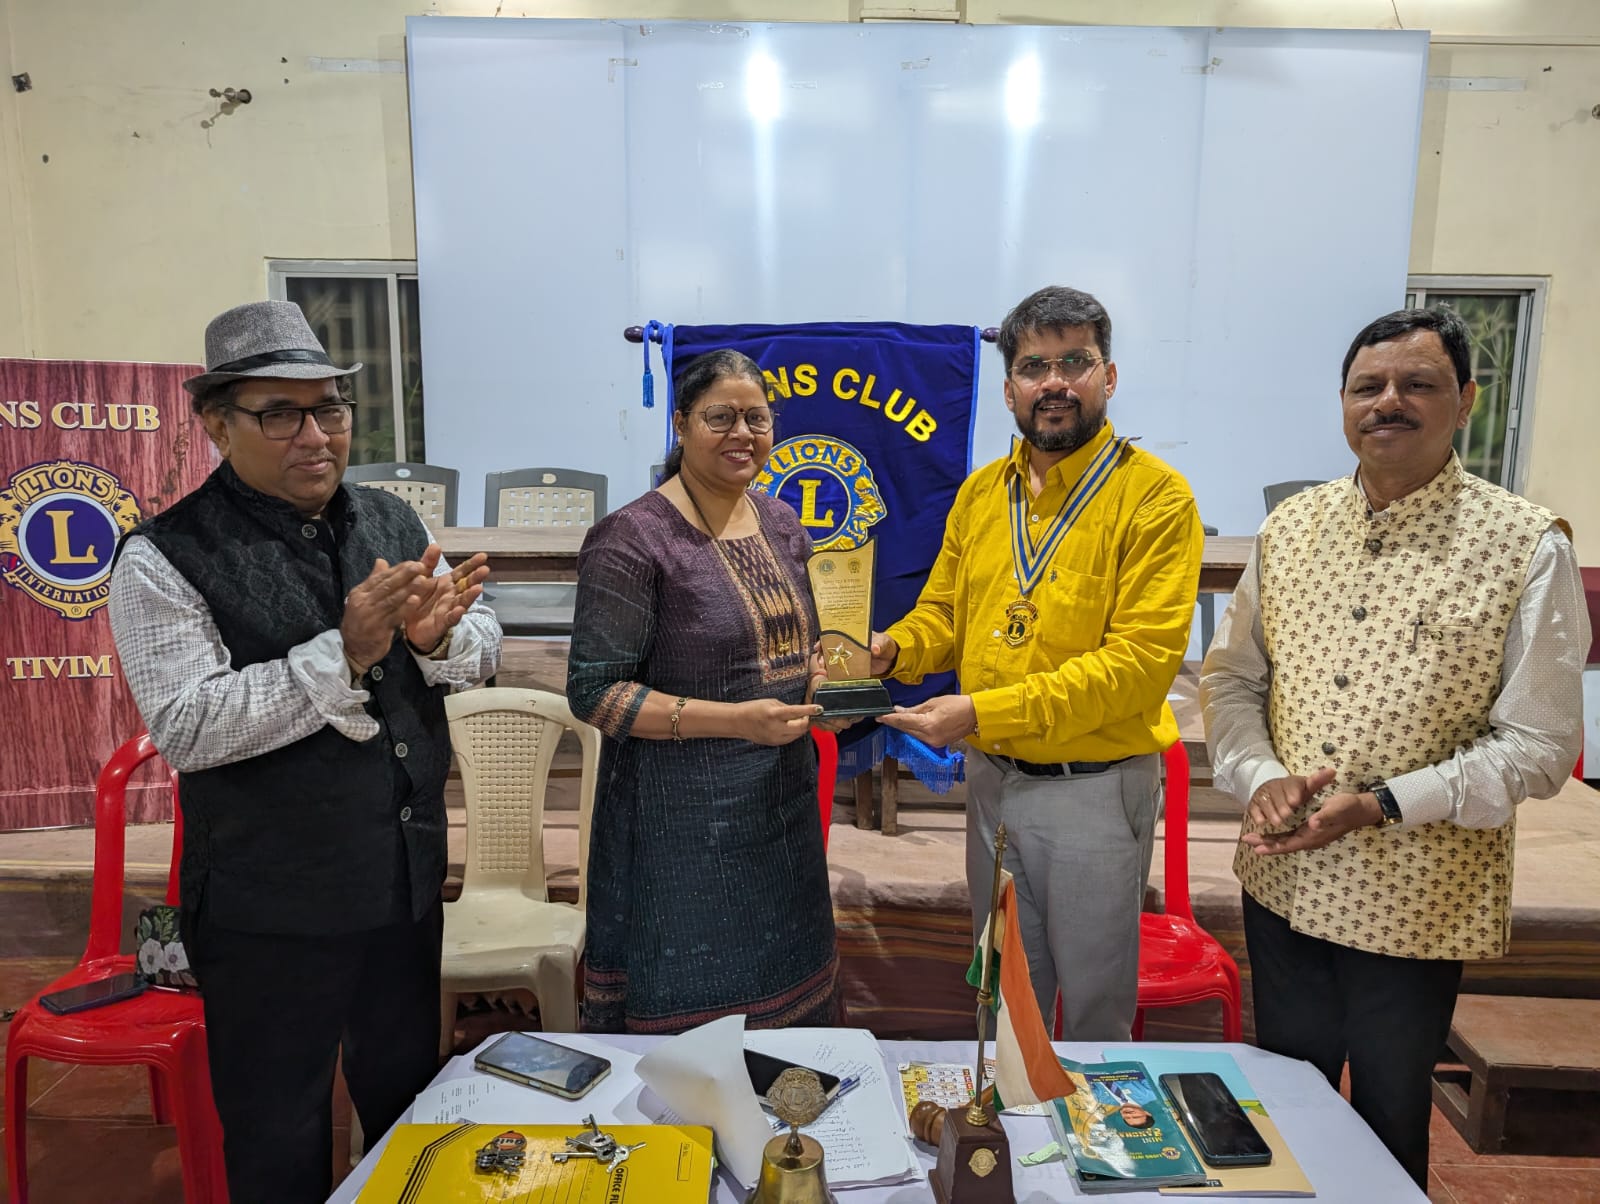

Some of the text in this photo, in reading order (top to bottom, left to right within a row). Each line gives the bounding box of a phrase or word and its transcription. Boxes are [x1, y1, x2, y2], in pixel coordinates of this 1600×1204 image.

[0, 400, 161, 431] NS CLUB
[761, 363, 938, 442] NS CLUB
[774, 442, 857, 474] LIONS
[20, 467, 111, 499] LIONS
[798, 479, 834, 528] L
[45, 510, 99, 564] L
[19, 570, 110, 602] INTERNATIO
[6, 655, 114, 680] TIVIM
[611, 1167, 625, 1192] OFFICE
